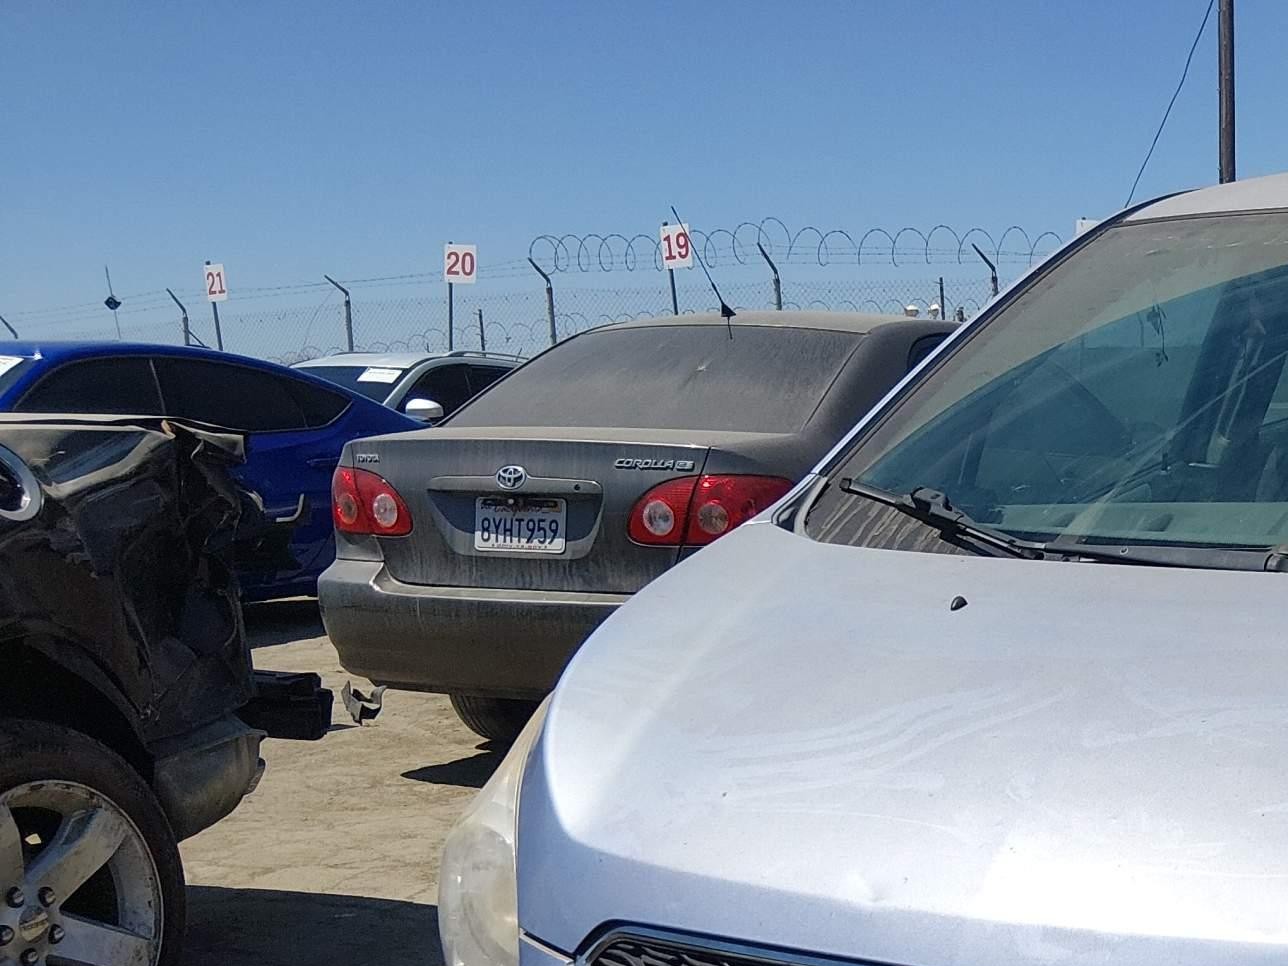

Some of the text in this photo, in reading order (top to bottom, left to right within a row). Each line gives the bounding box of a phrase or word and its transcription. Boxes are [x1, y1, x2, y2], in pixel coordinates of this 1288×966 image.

[663, 232, 689, 261] 19
[446, 251, 475, 276] 20
[206, 271, 226, 295] 21
[615, 458, 675, 471] COROLLA
[480, 517, 560, 545] 8YHT959
